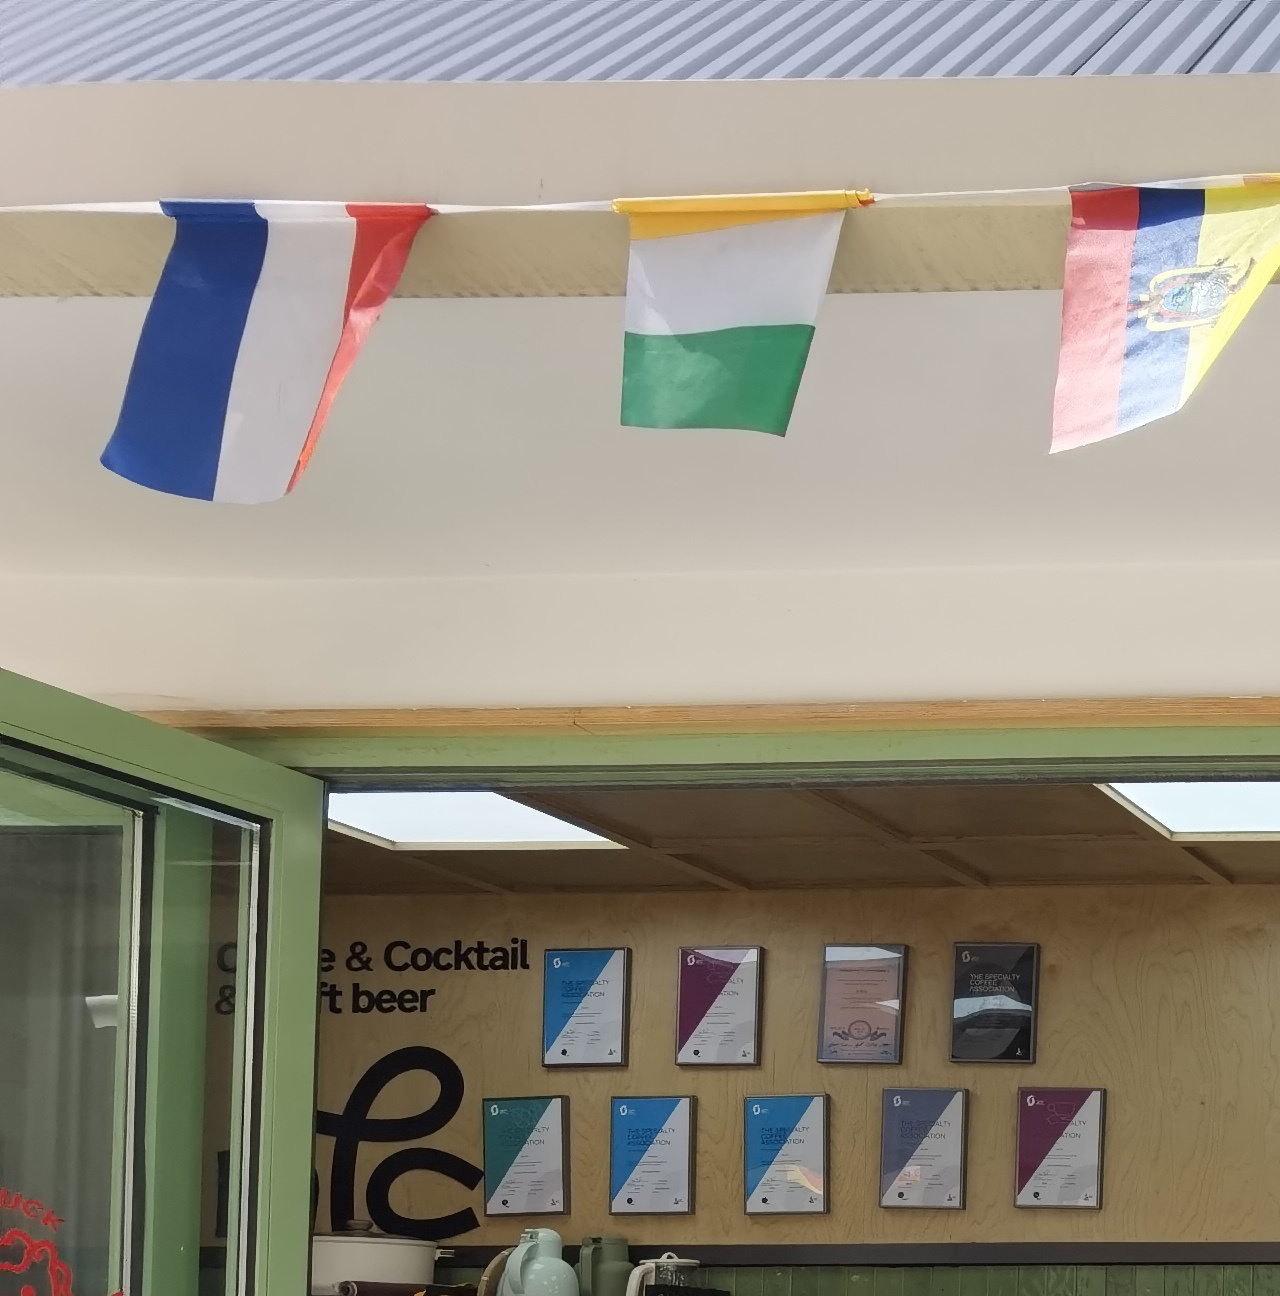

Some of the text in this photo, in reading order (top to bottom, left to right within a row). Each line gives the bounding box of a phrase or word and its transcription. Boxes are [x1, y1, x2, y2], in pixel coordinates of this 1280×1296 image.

[345, 943, 373, 971] &
[383, 938, 529, 971] Cocktail
[351, 984, 435, 1014] beer
